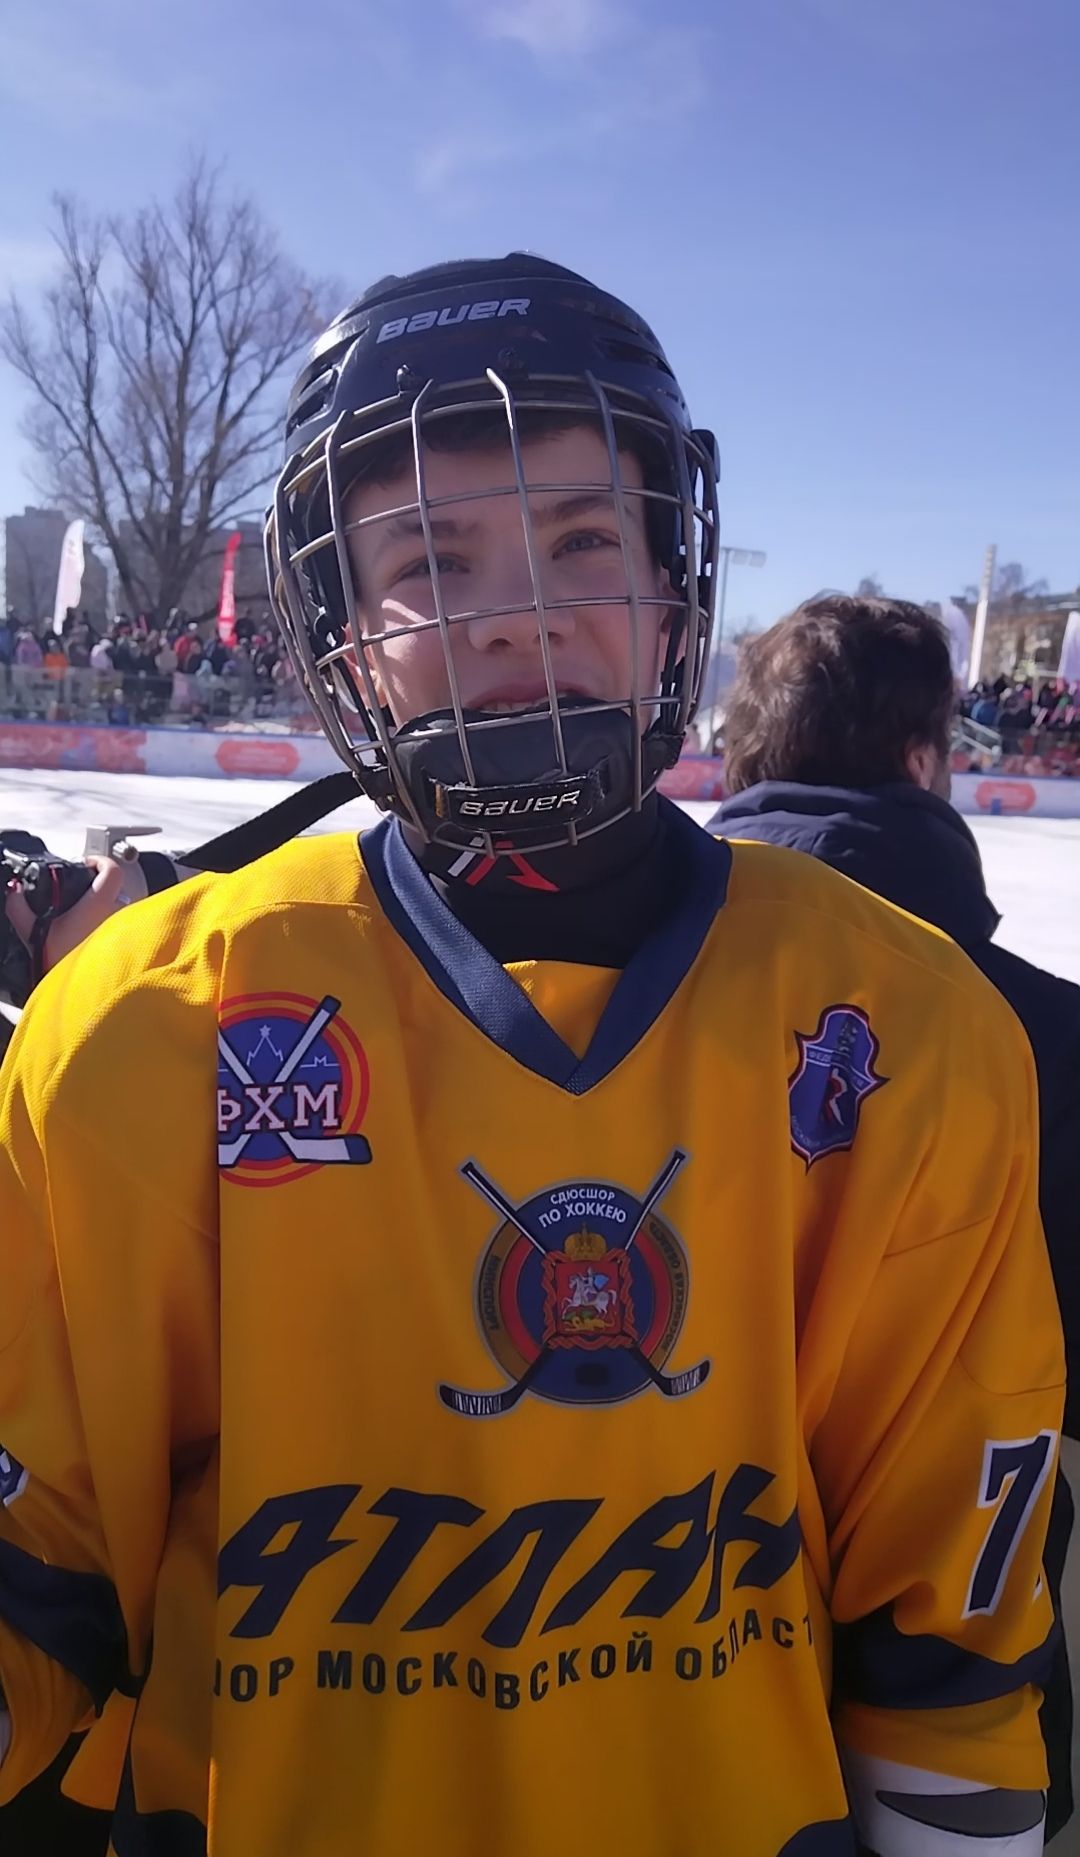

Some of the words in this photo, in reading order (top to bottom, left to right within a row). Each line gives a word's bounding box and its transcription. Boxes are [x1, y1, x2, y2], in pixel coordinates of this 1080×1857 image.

[217, 1083, 340, 1132] ФХМ
[538, 1208, 562, 1228] ПО
[564, 1201, 627, 1223] ХОККЕЮ
[550, 1188, 616, 1205] СДЮСШОР
[960, 1428, 1059, 1621] 7
[213, 1657, 295, 1703] ОР
[316, 1630, 653, 1711] МОСКОВСКОЙ
